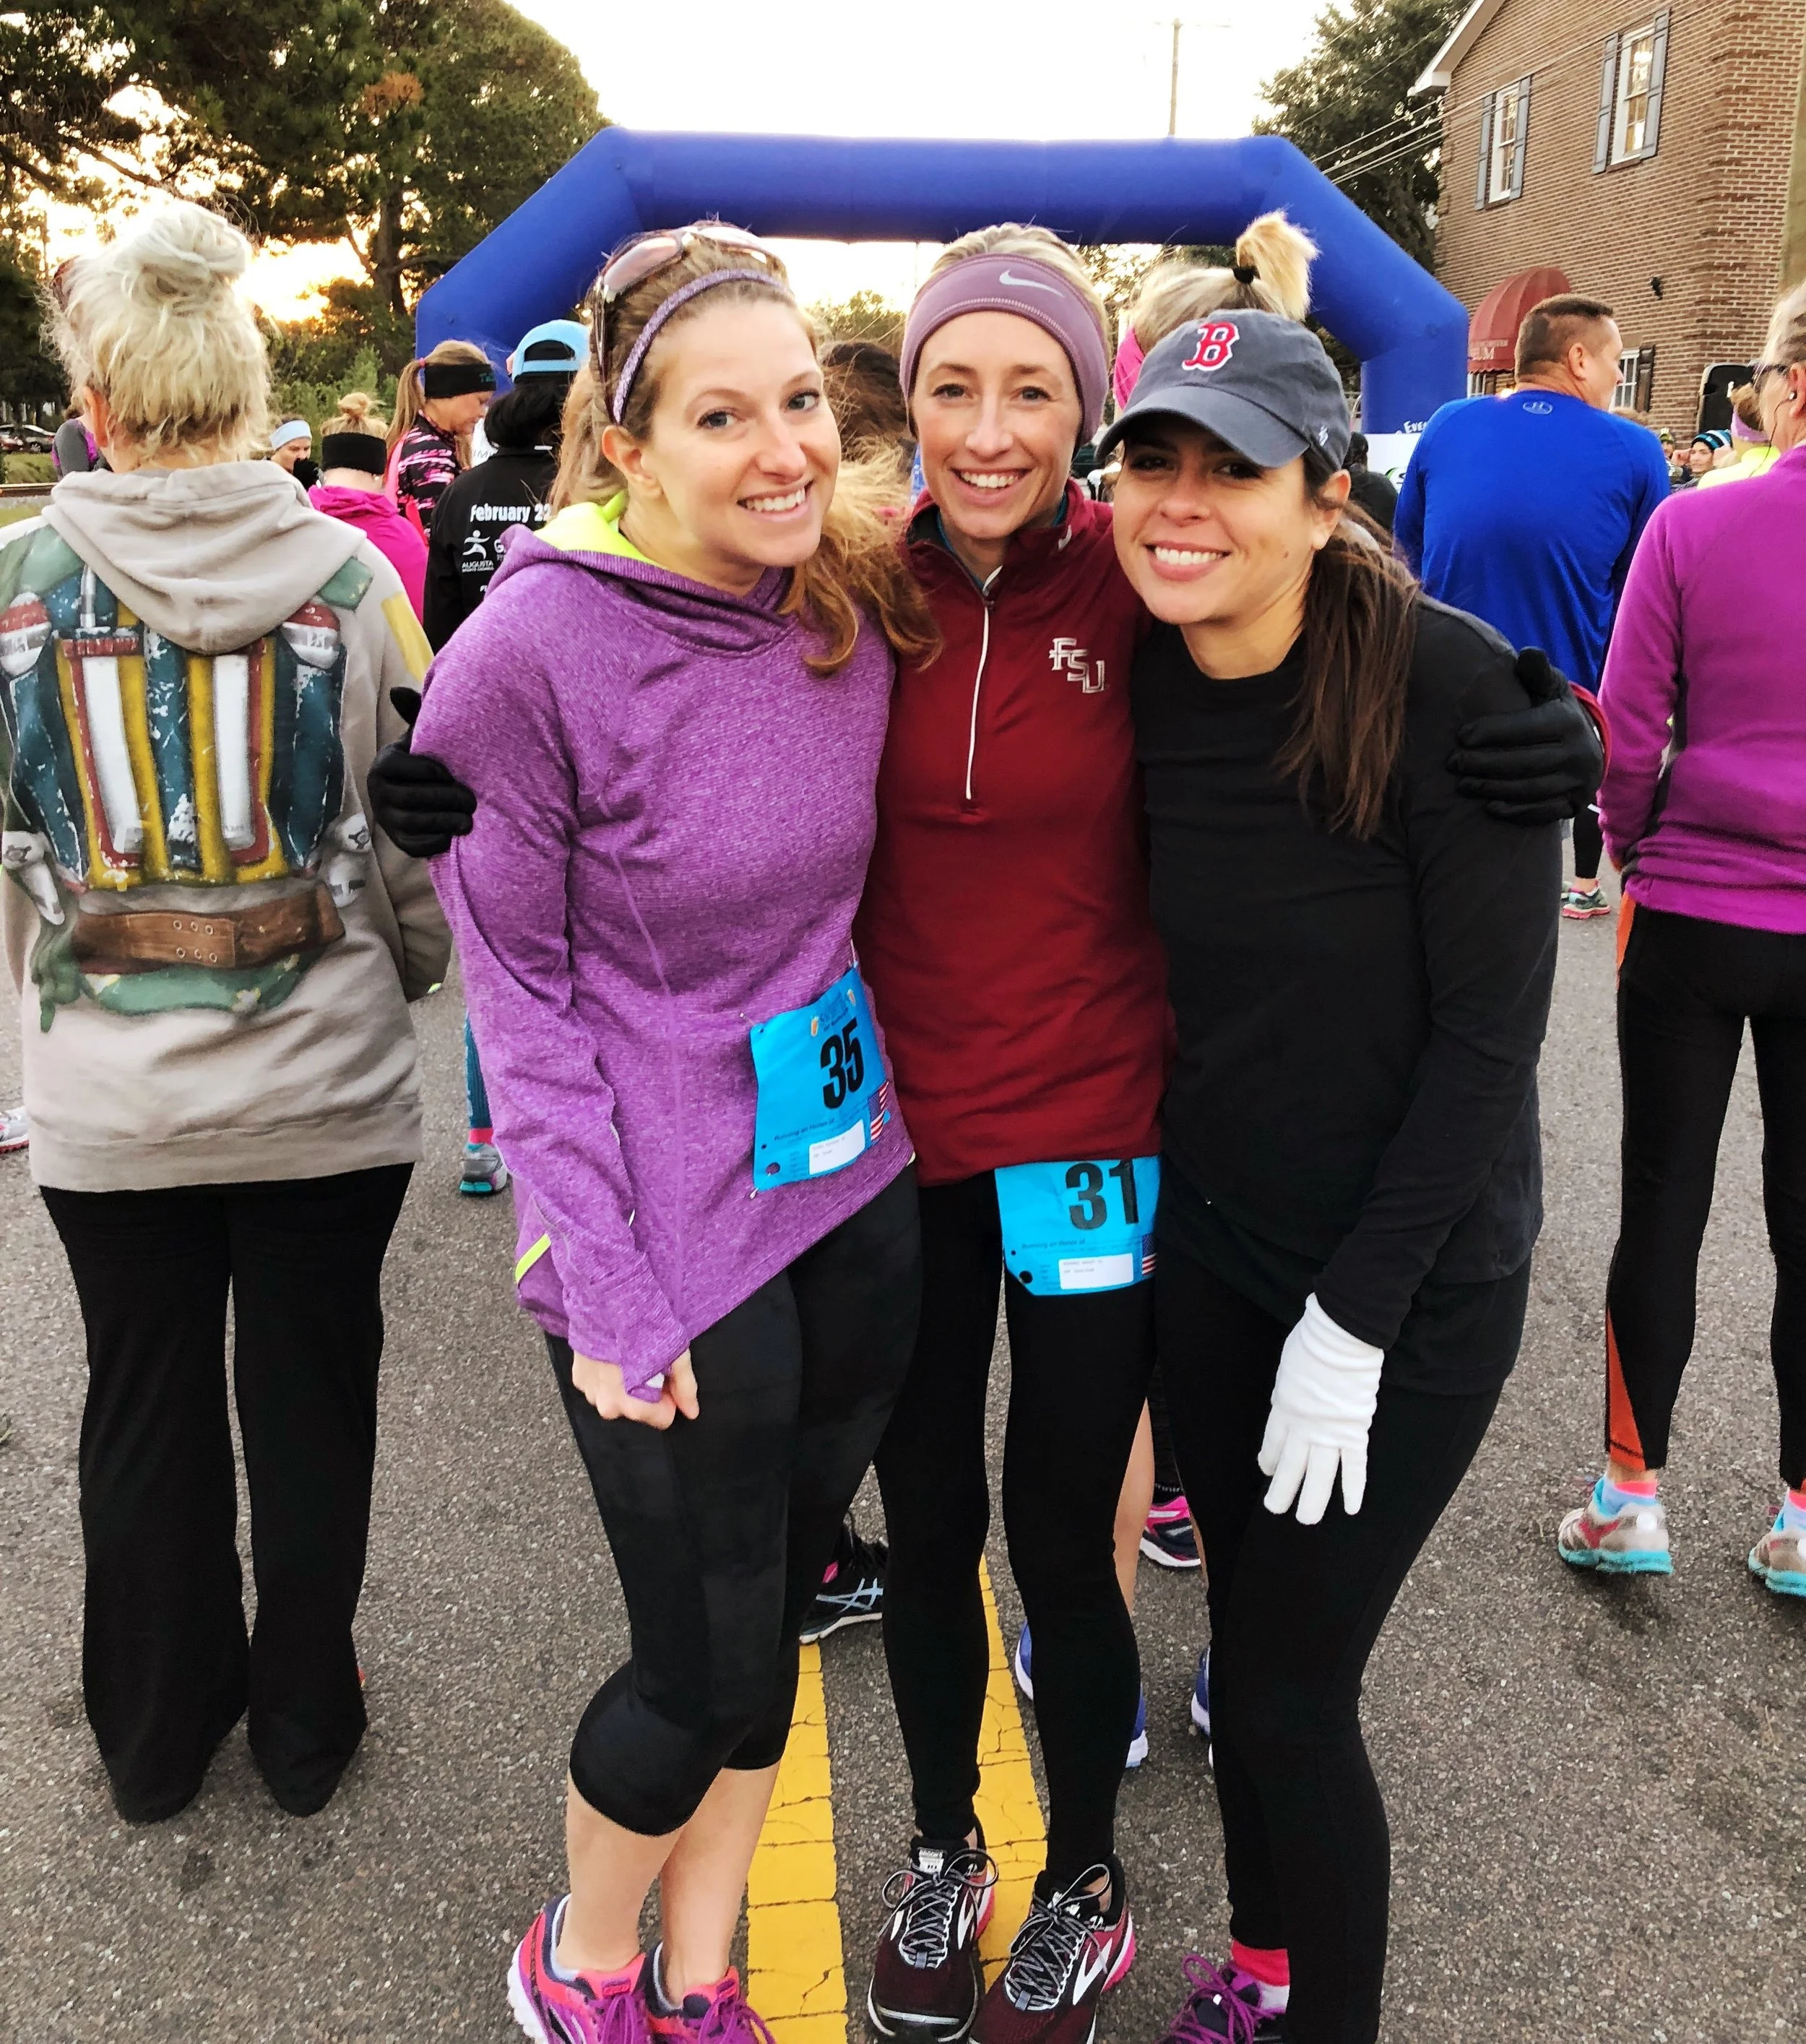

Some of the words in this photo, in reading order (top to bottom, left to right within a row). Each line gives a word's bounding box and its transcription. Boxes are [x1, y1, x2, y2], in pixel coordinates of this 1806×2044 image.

[1182, 321, 1240, 371] B
[470, 503, 531, 523] February
[1048, 637, 1106, 694] FSU
[820, 1017, 865, 1109] 35
[1065, 1159, 1139, 1231] 31
